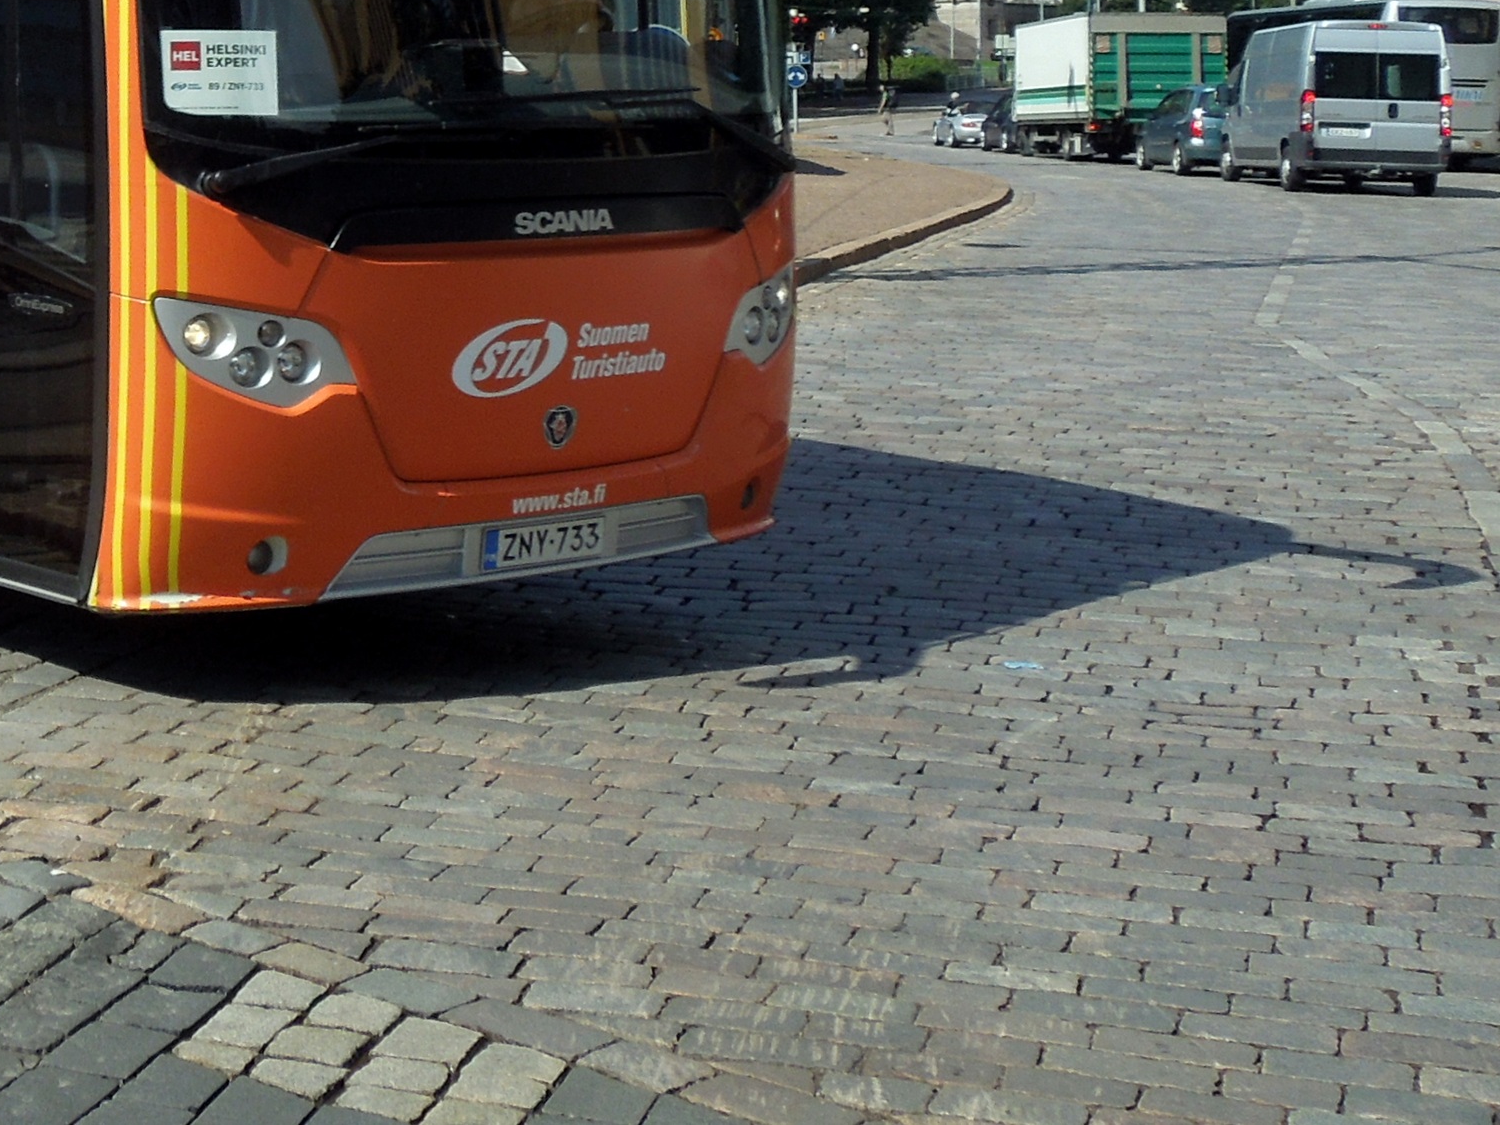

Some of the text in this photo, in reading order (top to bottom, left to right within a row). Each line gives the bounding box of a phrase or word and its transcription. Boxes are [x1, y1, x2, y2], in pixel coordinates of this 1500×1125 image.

[172, 51, 199, 62] HEL
[206, 44, 267, 55] HELSINKI
[206, 57, 258, 68] EXPERT
[515, 208, 615, 235] SCANIA
[577, 322, 649, 348] Suomen
[571, 348, 666, 380] Turistiauto
[512, 483, 607, 514] www.sta.fi
[502, 523, 599, 561] ZNY-733
